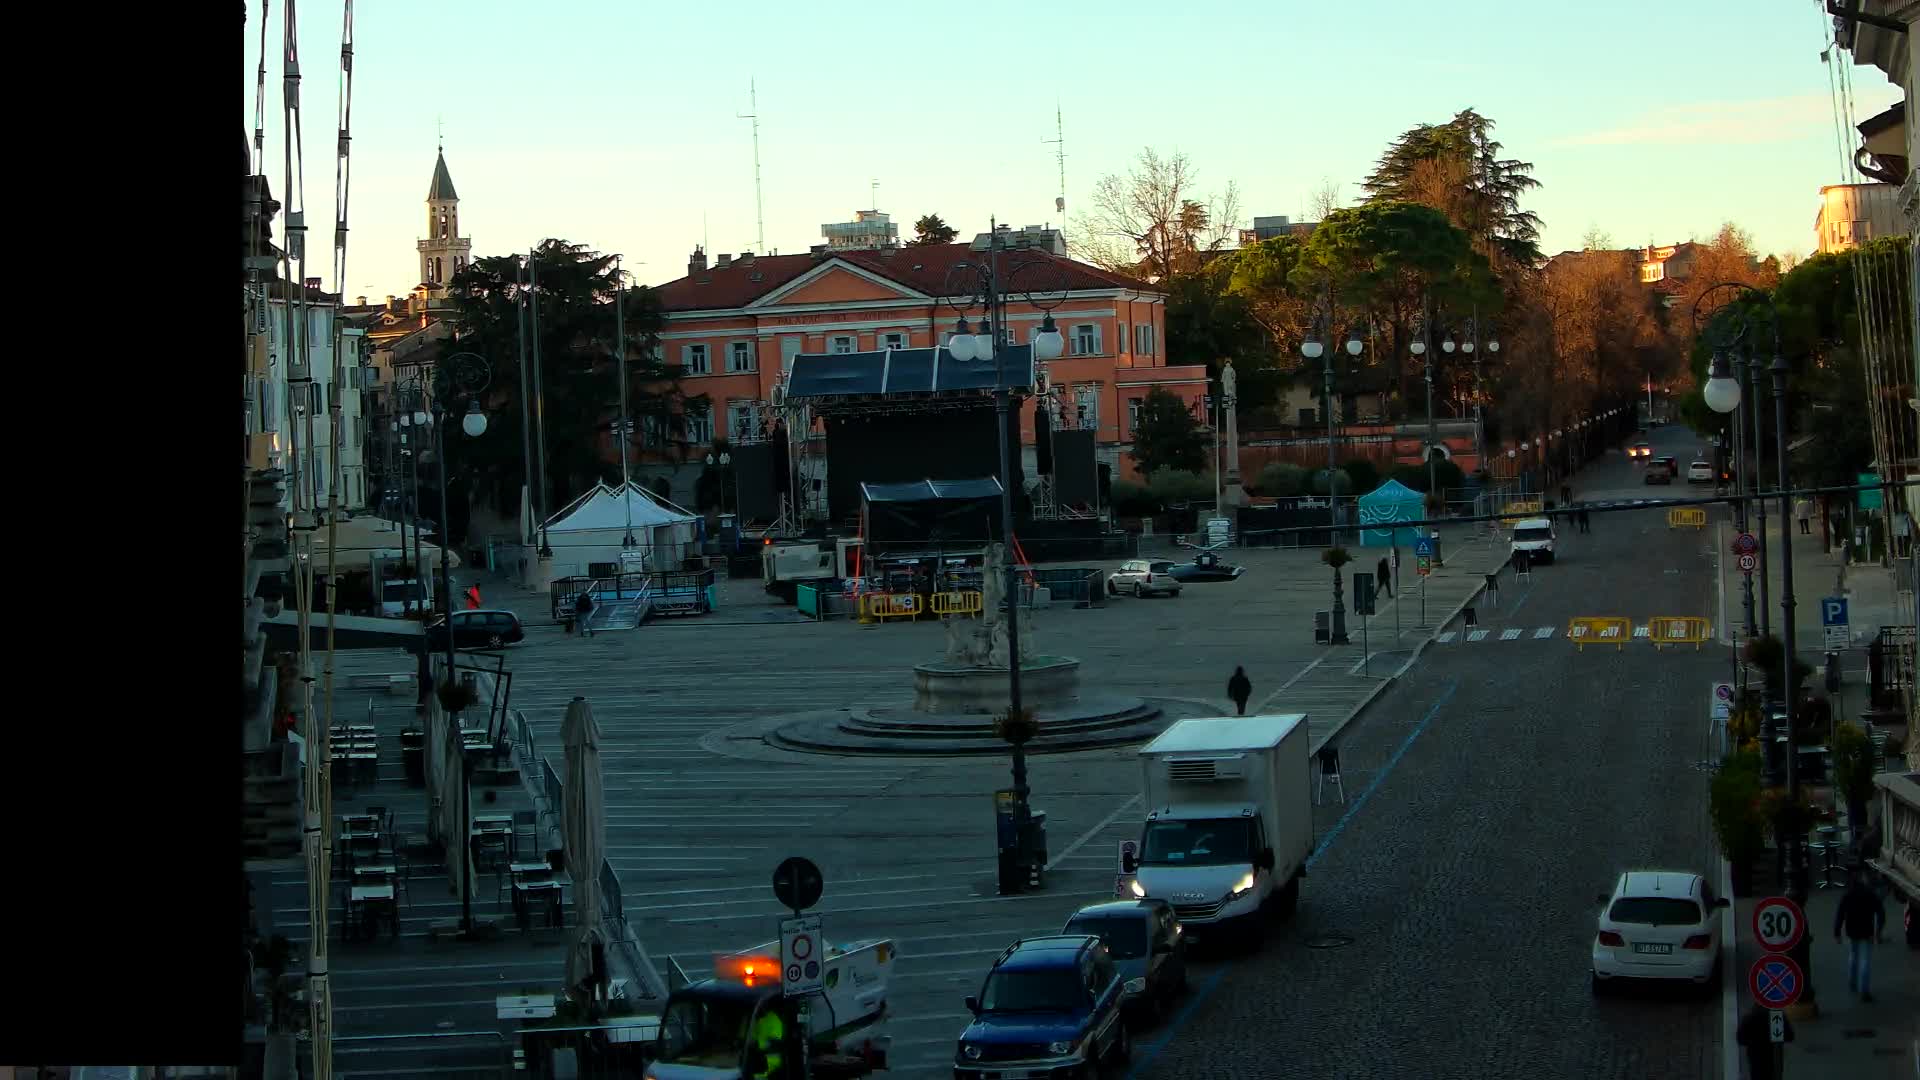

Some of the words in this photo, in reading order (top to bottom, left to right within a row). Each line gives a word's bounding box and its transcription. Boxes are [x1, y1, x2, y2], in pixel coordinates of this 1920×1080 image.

[1742, 558, 1753, 566] 20
[1827, 602, 1842, 621] P
[1762, 911, 1792, 937] 30
